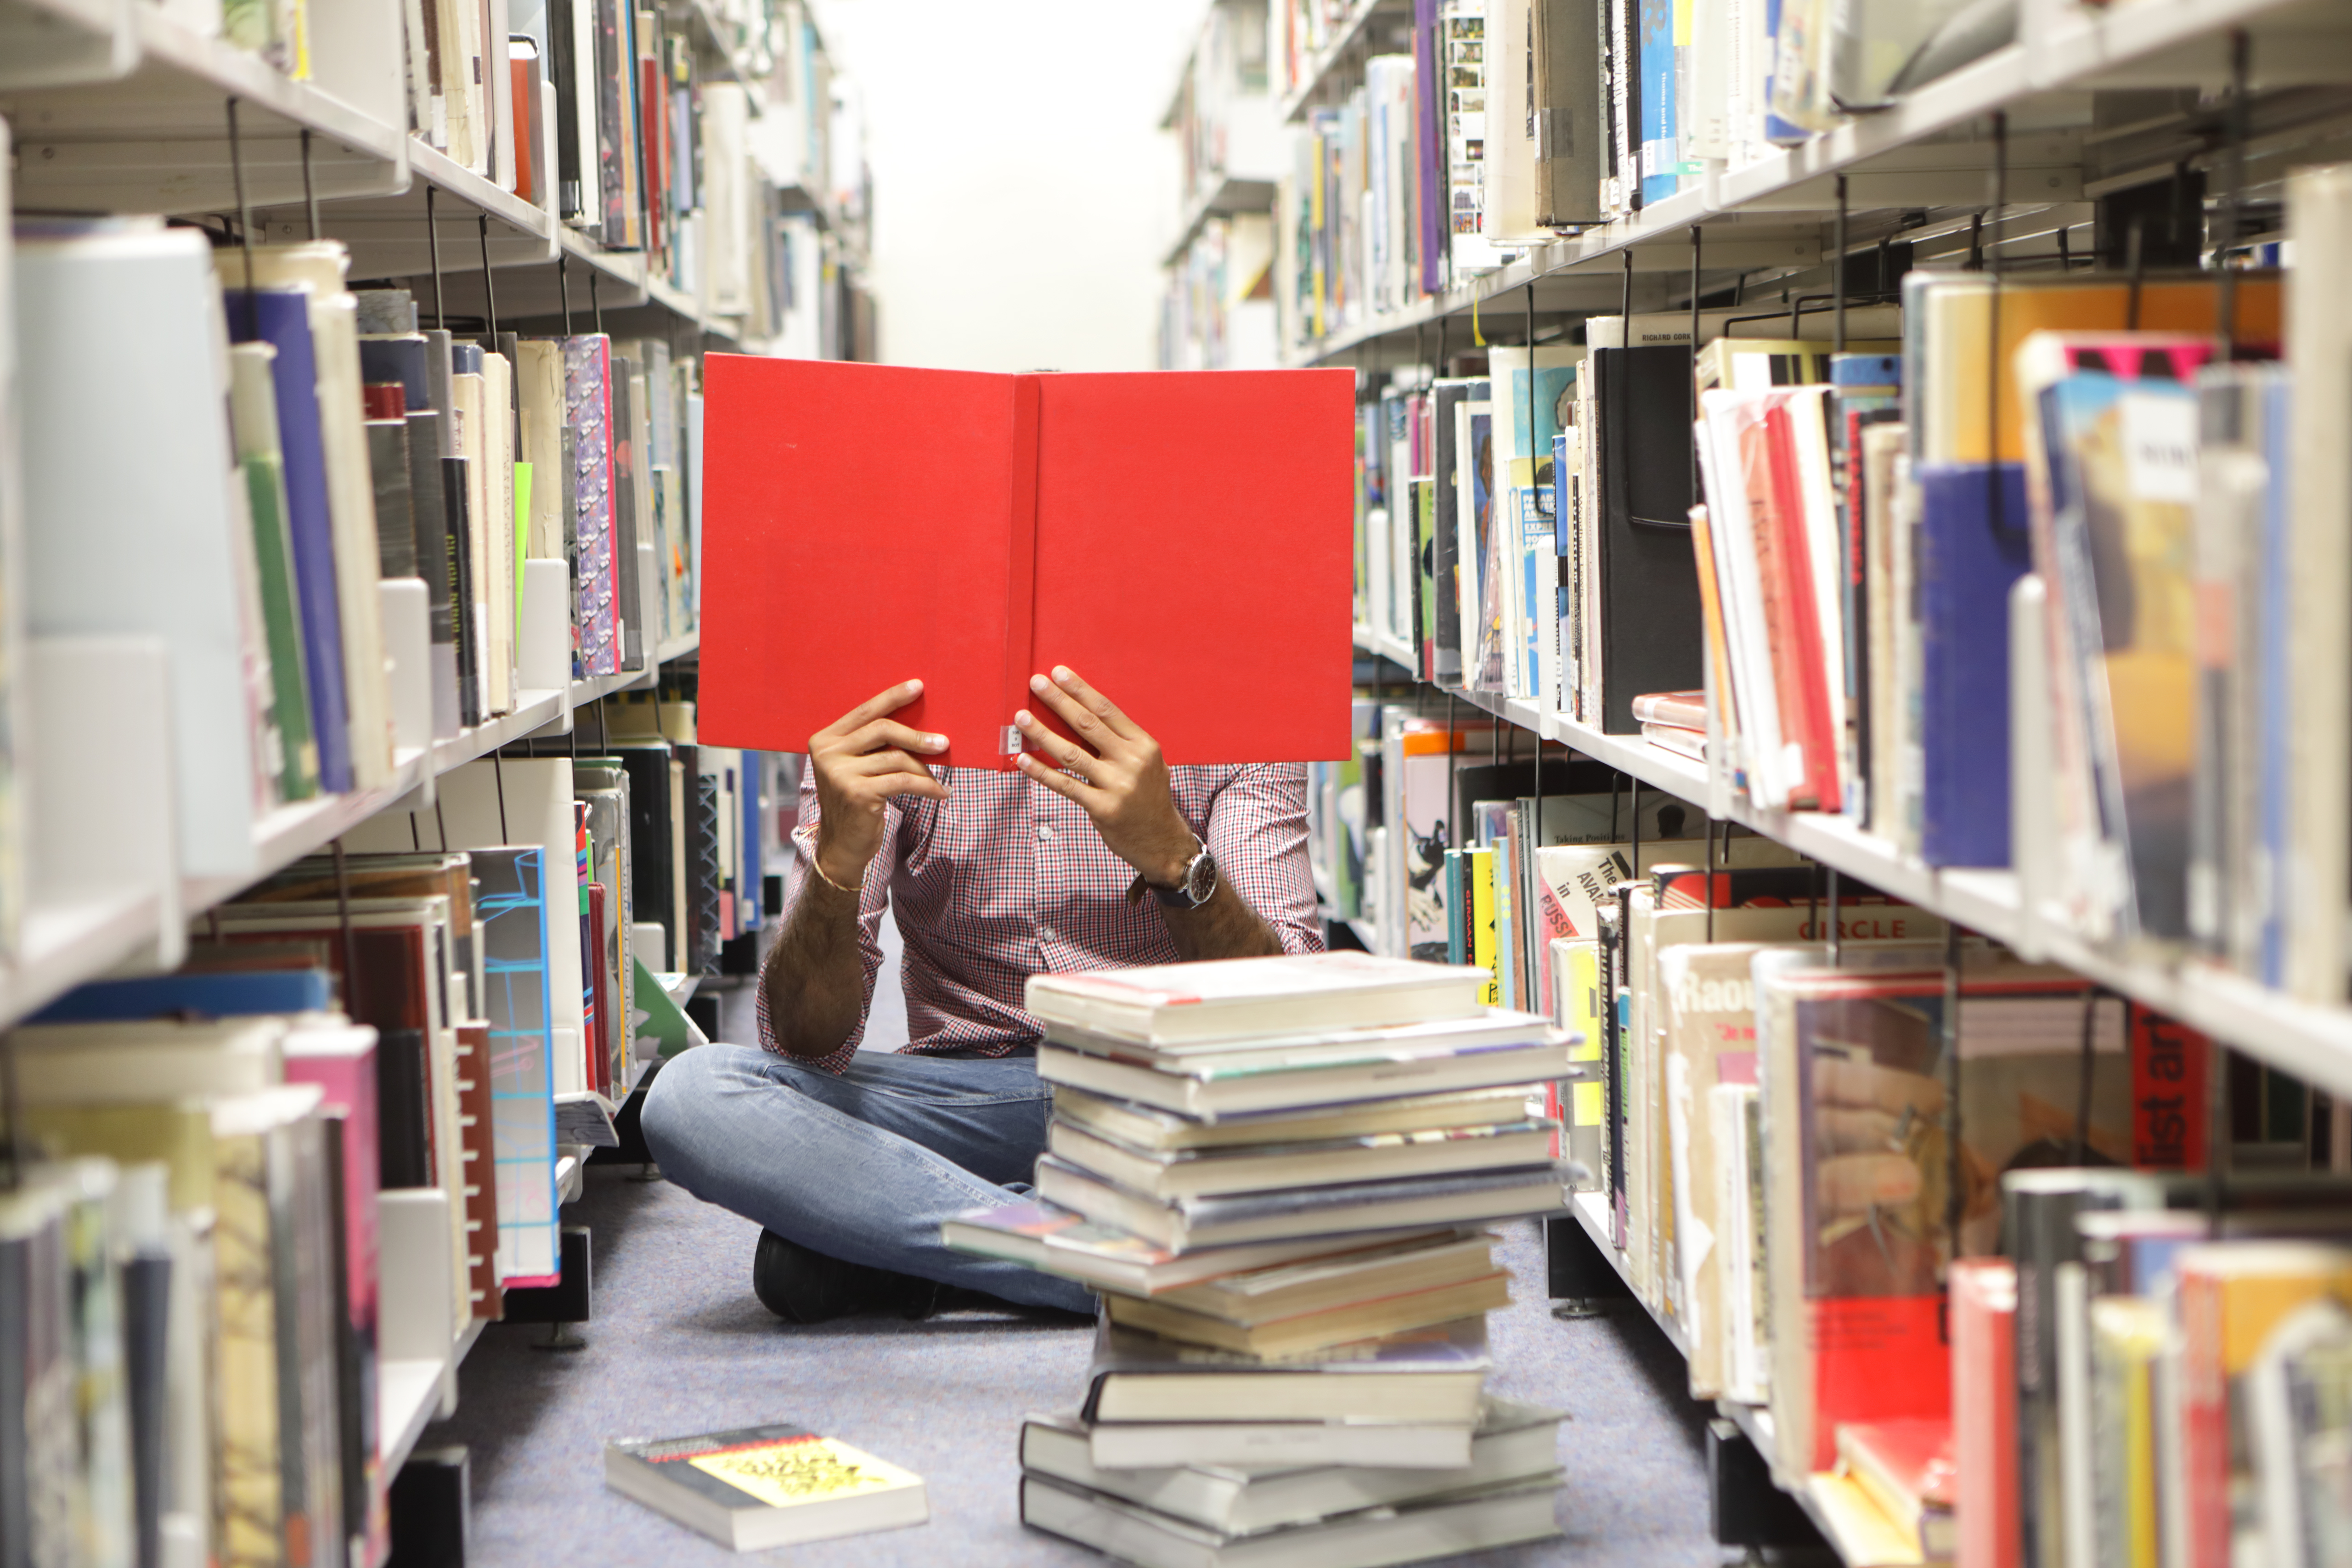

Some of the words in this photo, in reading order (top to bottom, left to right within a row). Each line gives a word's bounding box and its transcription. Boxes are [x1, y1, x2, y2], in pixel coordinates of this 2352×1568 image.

[1642, 334, 1670, 342] RICHARD
[1673, 333, 1691, 341] CORK
[1554, 835, 1583, 844] Taking
[1586, 834, 1625, 842] Positins
[1598, 857, 1617, 885] The
[1557, 882, 1571, 899] in
[1798, 920, 1906, 941] CIRCLE
[1600, 944, 1609, 1030] RUSSIAN
